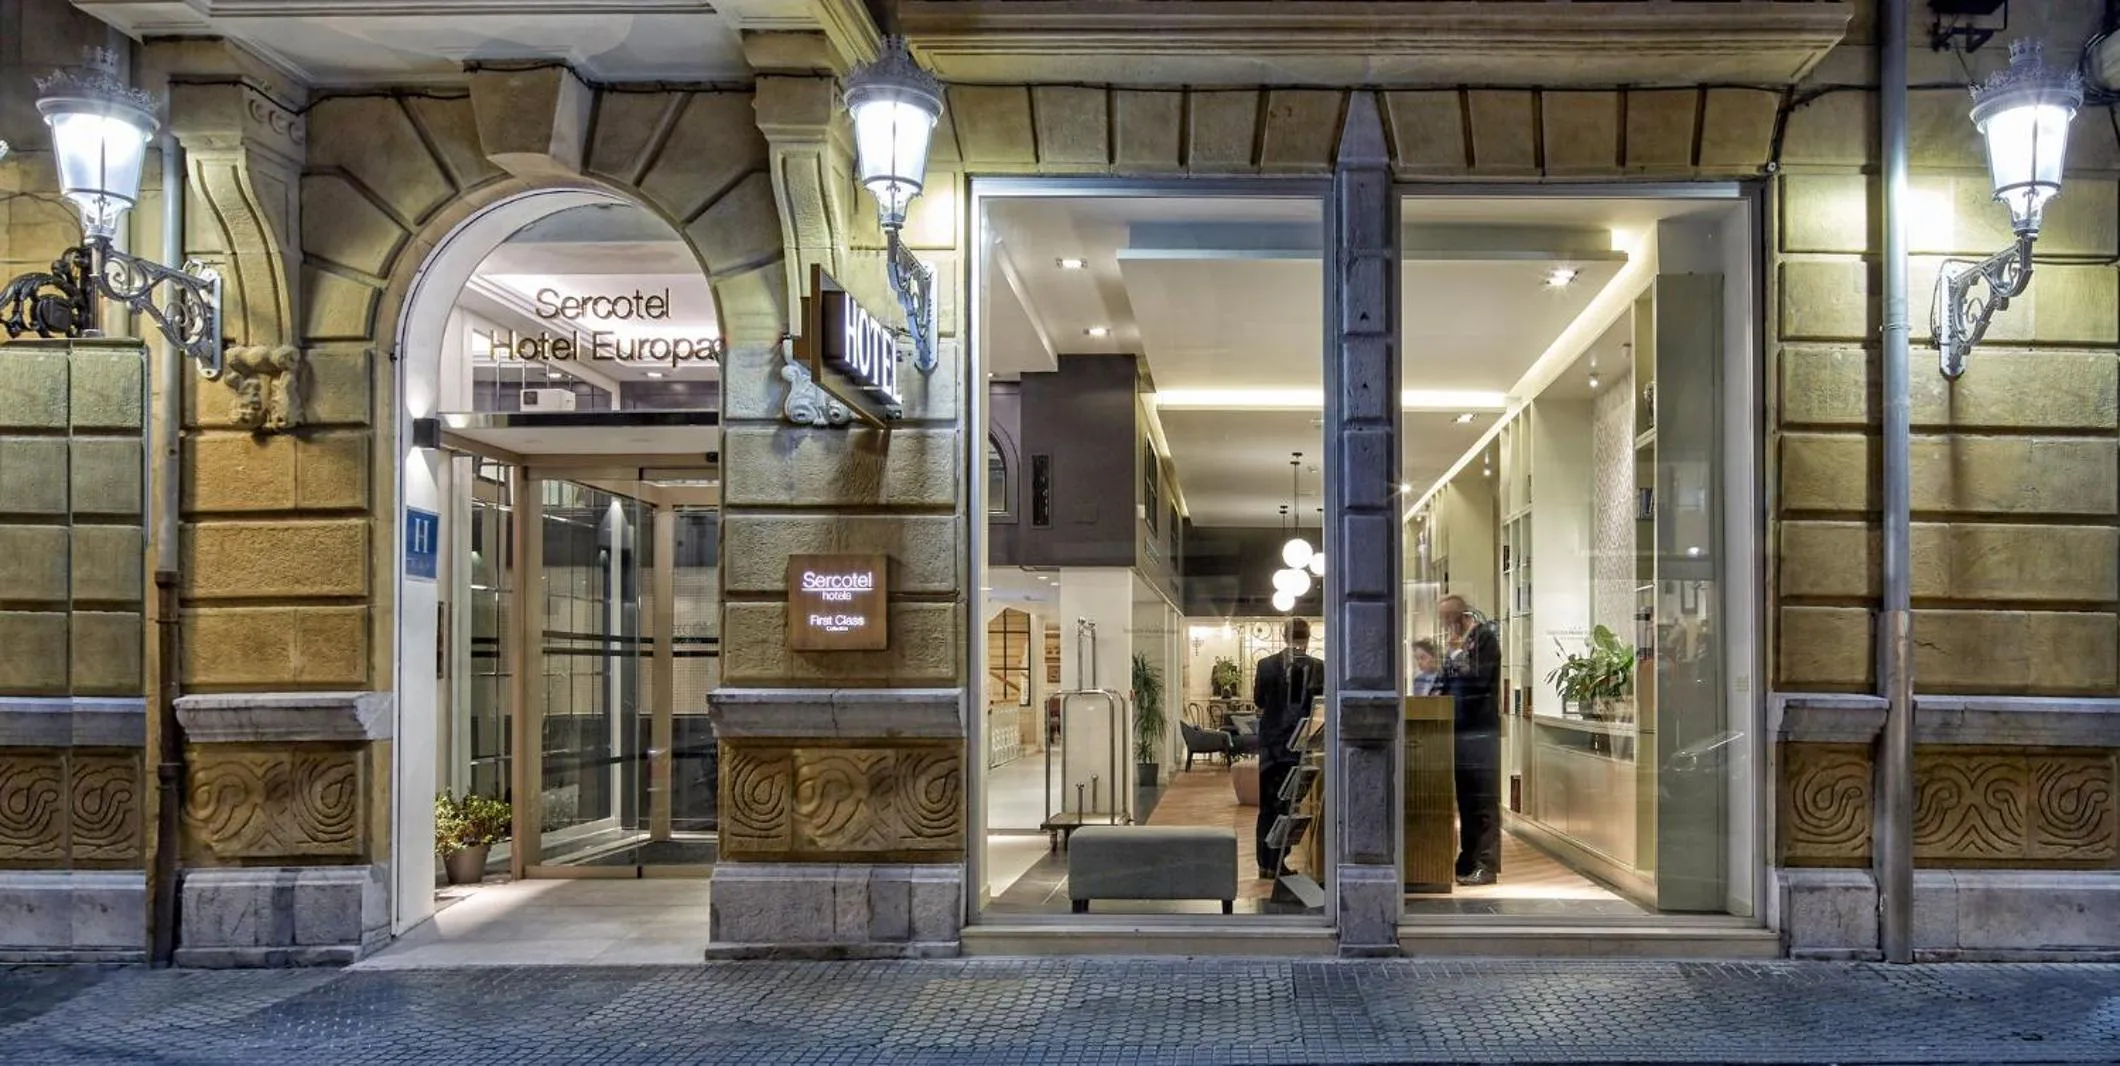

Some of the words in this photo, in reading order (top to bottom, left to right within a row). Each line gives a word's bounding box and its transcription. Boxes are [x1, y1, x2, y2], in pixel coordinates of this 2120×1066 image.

[536, 287, 670, 320] Sercotel
[490, 329, 578, 362] Hotel
[593, 331, 715, 368] Europa
[845, 292, 902, 404] HOTEL
[414, 518, 429, 553] H
[802, 571, 873, 588] Sercotel
[821, 591, 852, 601] hotels
[810, 615, 832, 626] First
[835, 615, 865, 626] Class
